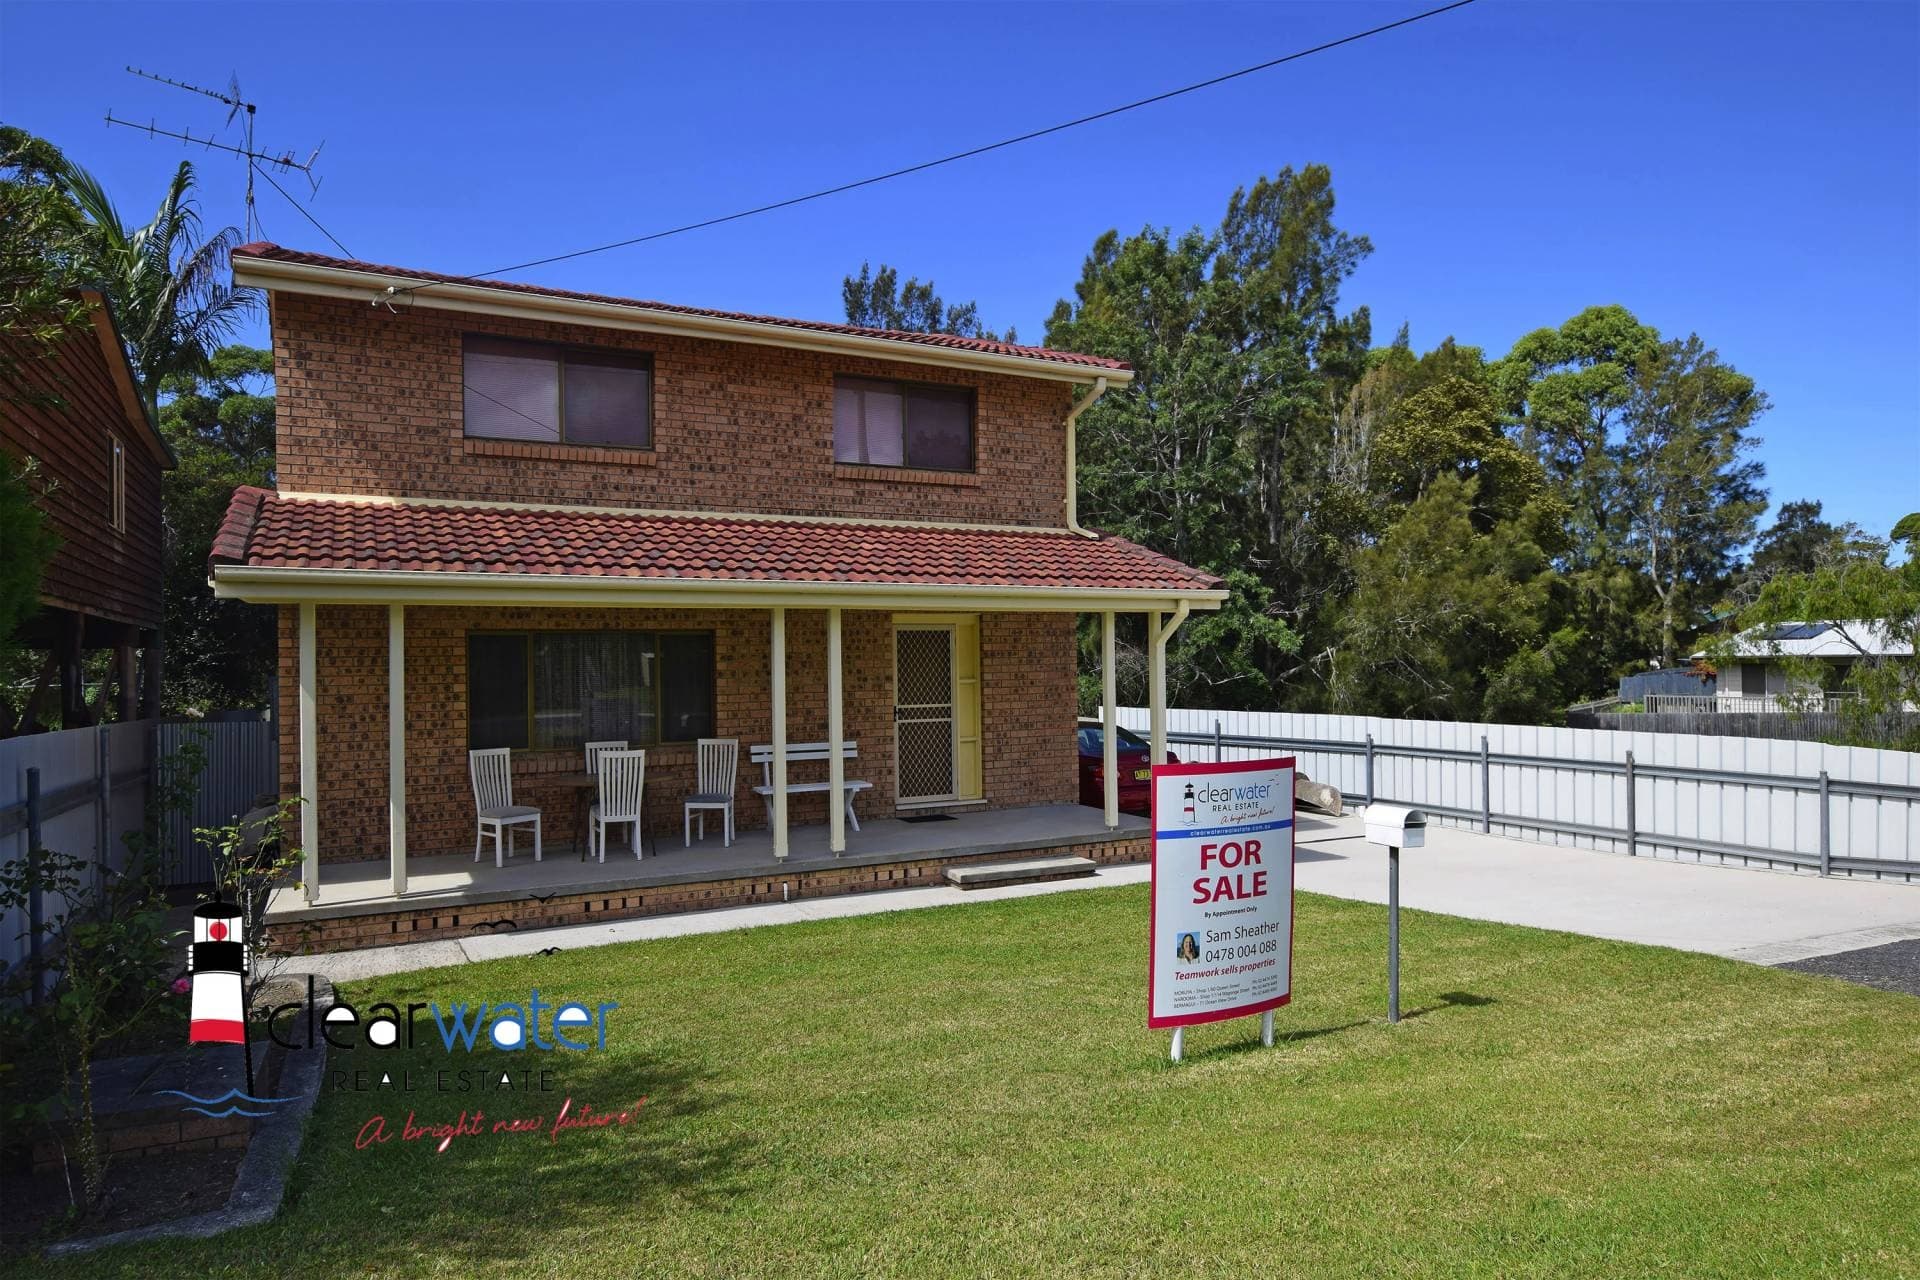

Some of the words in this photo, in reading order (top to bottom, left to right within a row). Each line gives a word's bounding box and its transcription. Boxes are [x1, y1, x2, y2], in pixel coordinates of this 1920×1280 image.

[1198, 782, 1271, 803] clearwater
[1212, 803, 1232, 812] REAL
[1235, 801, 1259, 811] ESTATE
[1200, 840, 1262, 871] FOR
[1192, 870, 1267, 904] SALE
[1204, 911, 1212, 919] By
[1212, 907, 1246, 917] Appointment
[1247, 905, 1258, 913] Only
[1206, 930, 1231, 943] Sam
[1234, 921, 1280, 940] Sheather
[1205, 947, 1235, 963] 0478
[1237, 943, 1257, 959] 004
[1259, 939, 1277, 955] 088
[1175, 967, 1220, 981] Teamwork
[1220, 963, 1239, 975] sells
[1239, 957, 1276, 974] properties
